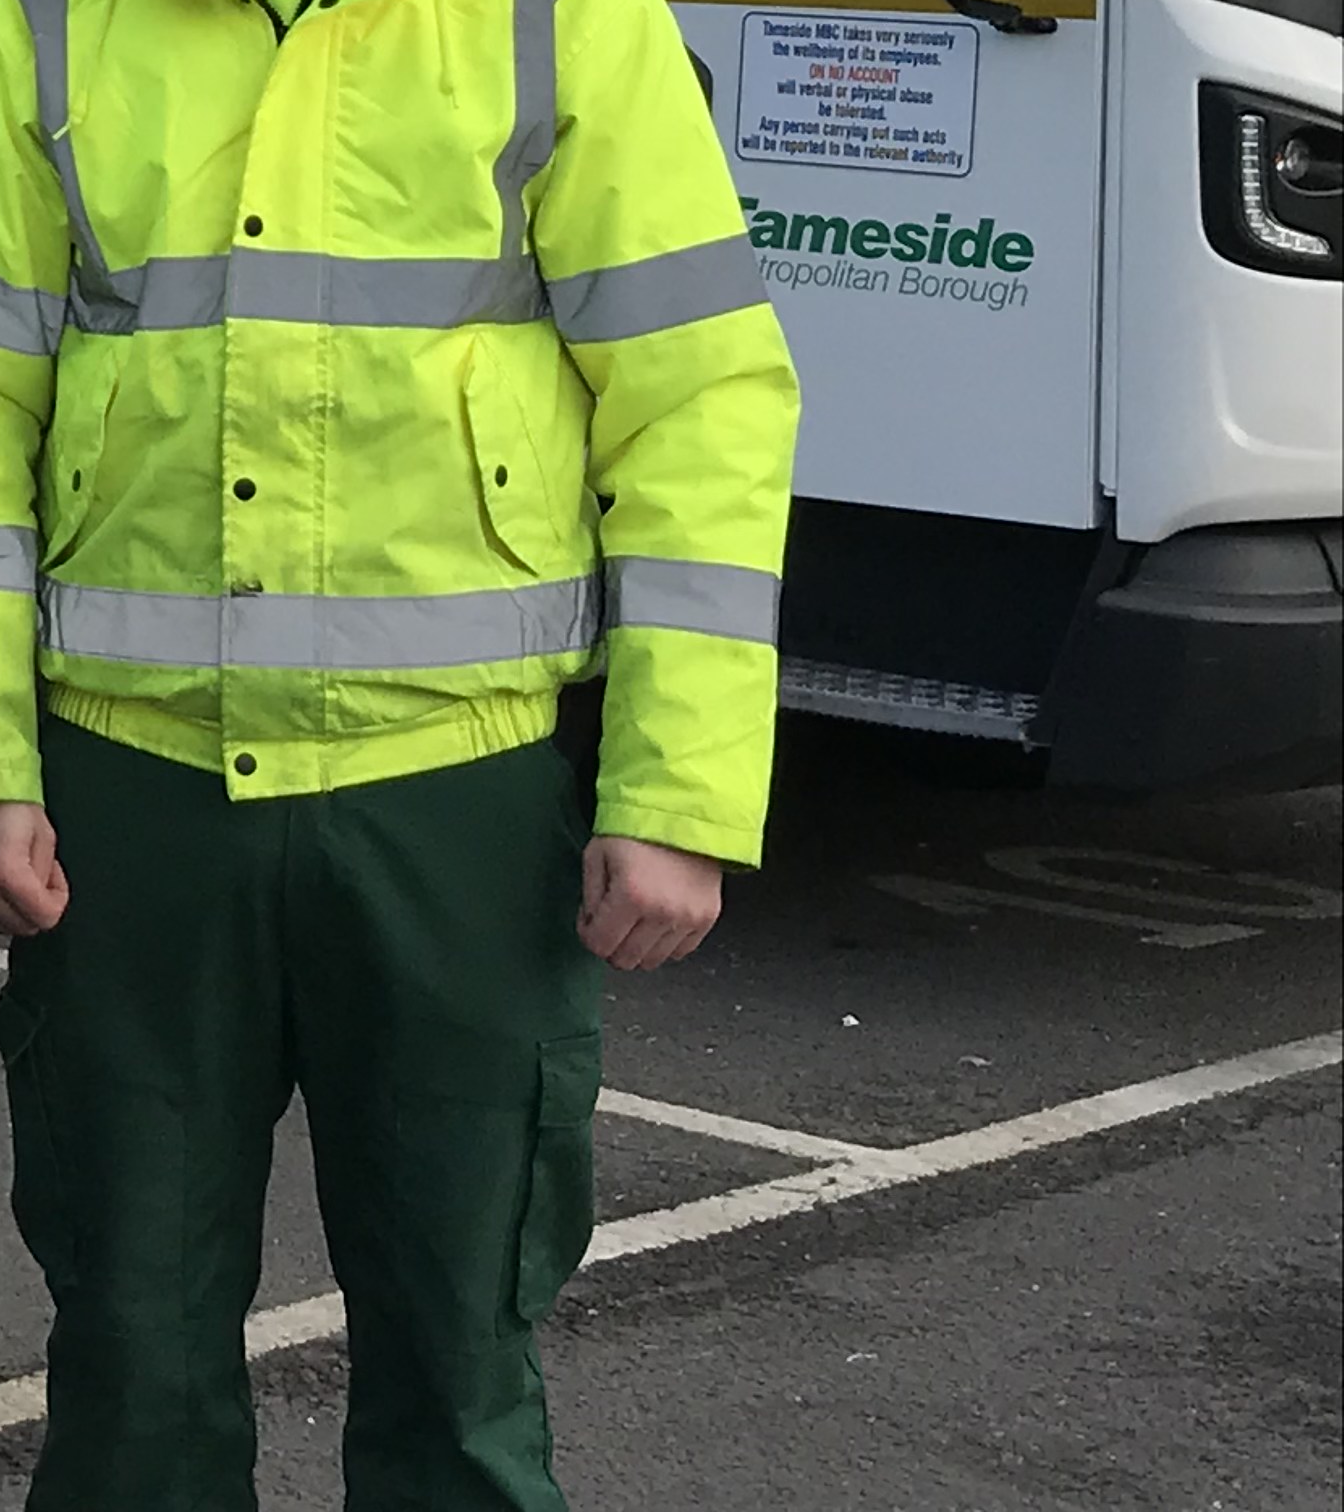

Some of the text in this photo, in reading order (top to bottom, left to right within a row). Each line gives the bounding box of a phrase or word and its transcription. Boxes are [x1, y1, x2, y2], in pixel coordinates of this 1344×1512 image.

[763, 21, 812, 39] Tameside
[843, 25, 872, 42] takes
[876, 30, 900, 46] very
[904, 29, 955, 49] seriously
[773, 41, 941, 67] the wellbeing of its employees.
[810, 63, 900, 84] ON NO ACCOUNT
[777, 79, 933, 104] will verbal or physical abuse
[818, 101, 832, 117] be
[759, 116, 946, 144] Any person carrying out such acts
[741, 134, 963, 168] will be reported to the relevant authority
[759, 254, 1030, 311] tropolitan Borough
